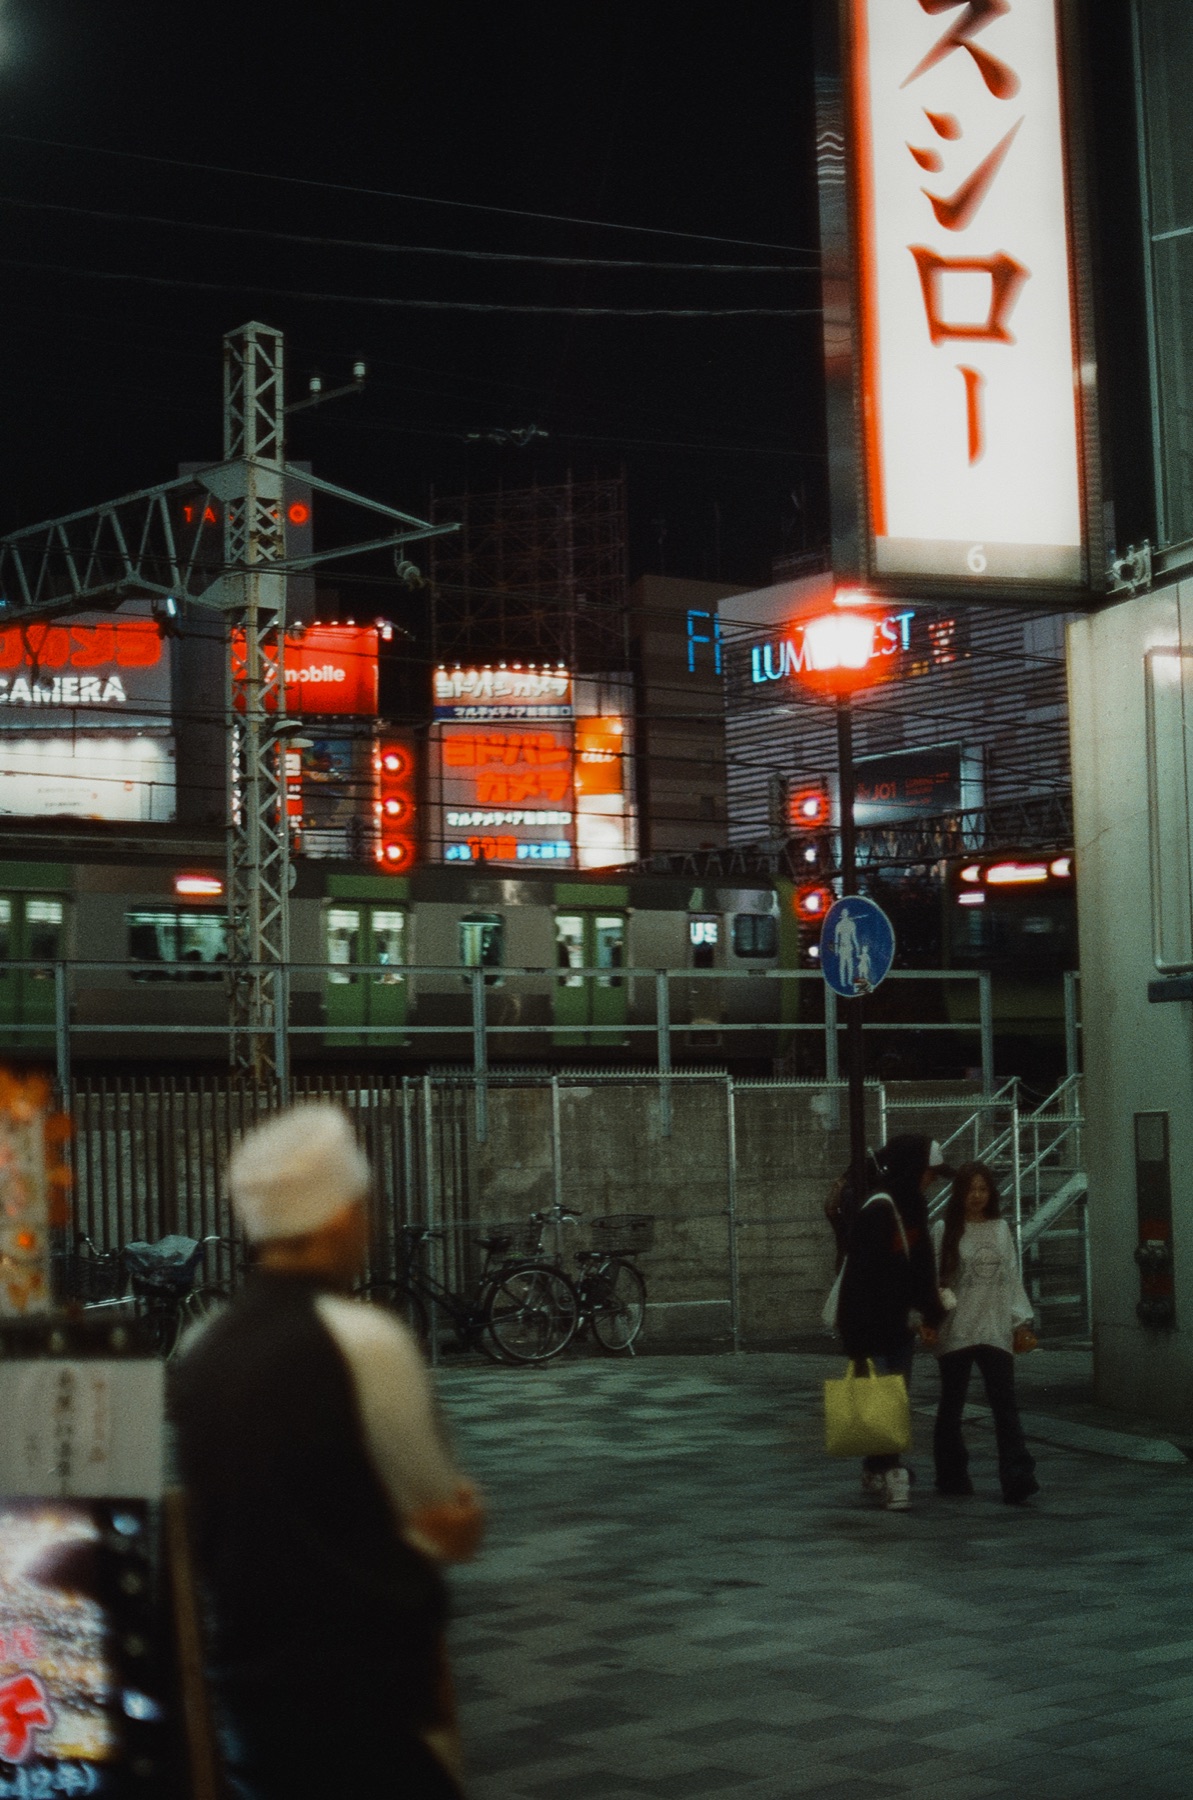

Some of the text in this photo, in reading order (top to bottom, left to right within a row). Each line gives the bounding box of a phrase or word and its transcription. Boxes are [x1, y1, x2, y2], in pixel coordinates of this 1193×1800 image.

[900, 0, 1033, 468] スシロー
[967, 544, 987, 574] 6
